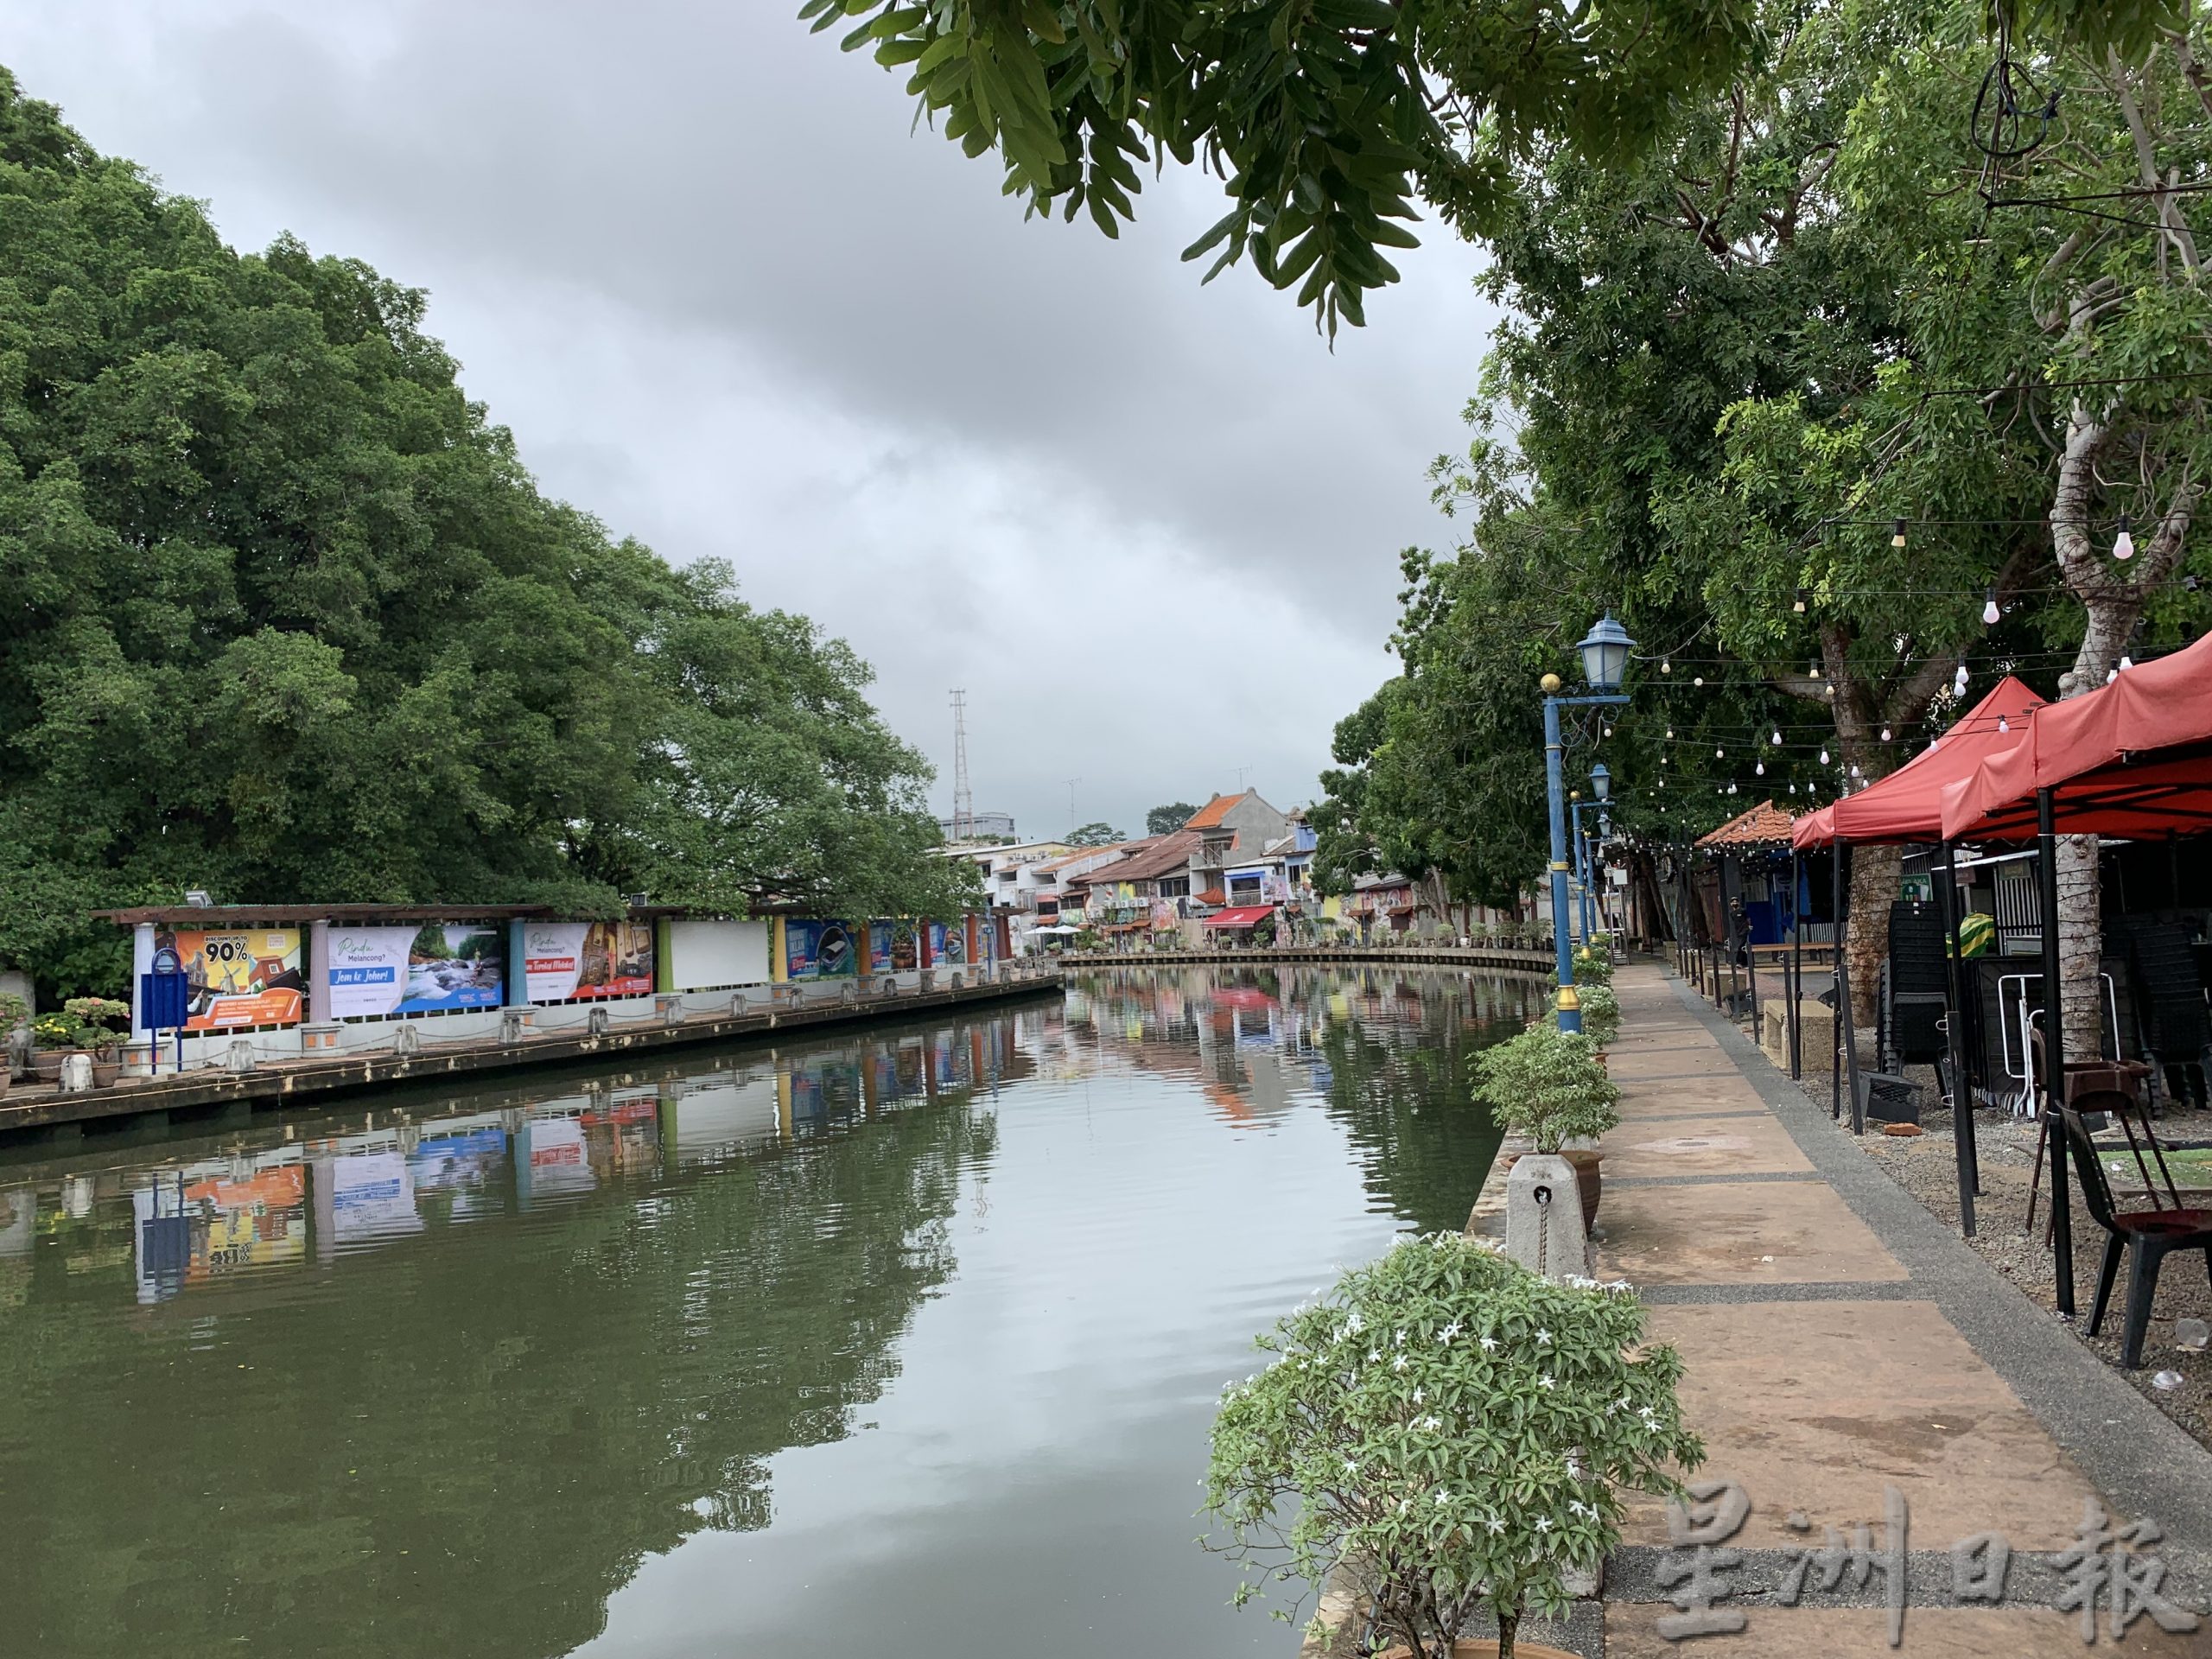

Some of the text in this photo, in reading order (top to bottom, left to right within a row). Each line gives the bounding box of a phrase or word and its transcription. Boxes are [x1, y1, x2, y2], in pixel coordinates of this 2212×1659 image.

[338, 938, 373, 956] Rindu
[530, 932, 556, 948] Rindu
[206, 942, 248, 962] 90%
[335, 969, 388, 984] Jom ke Johor!
